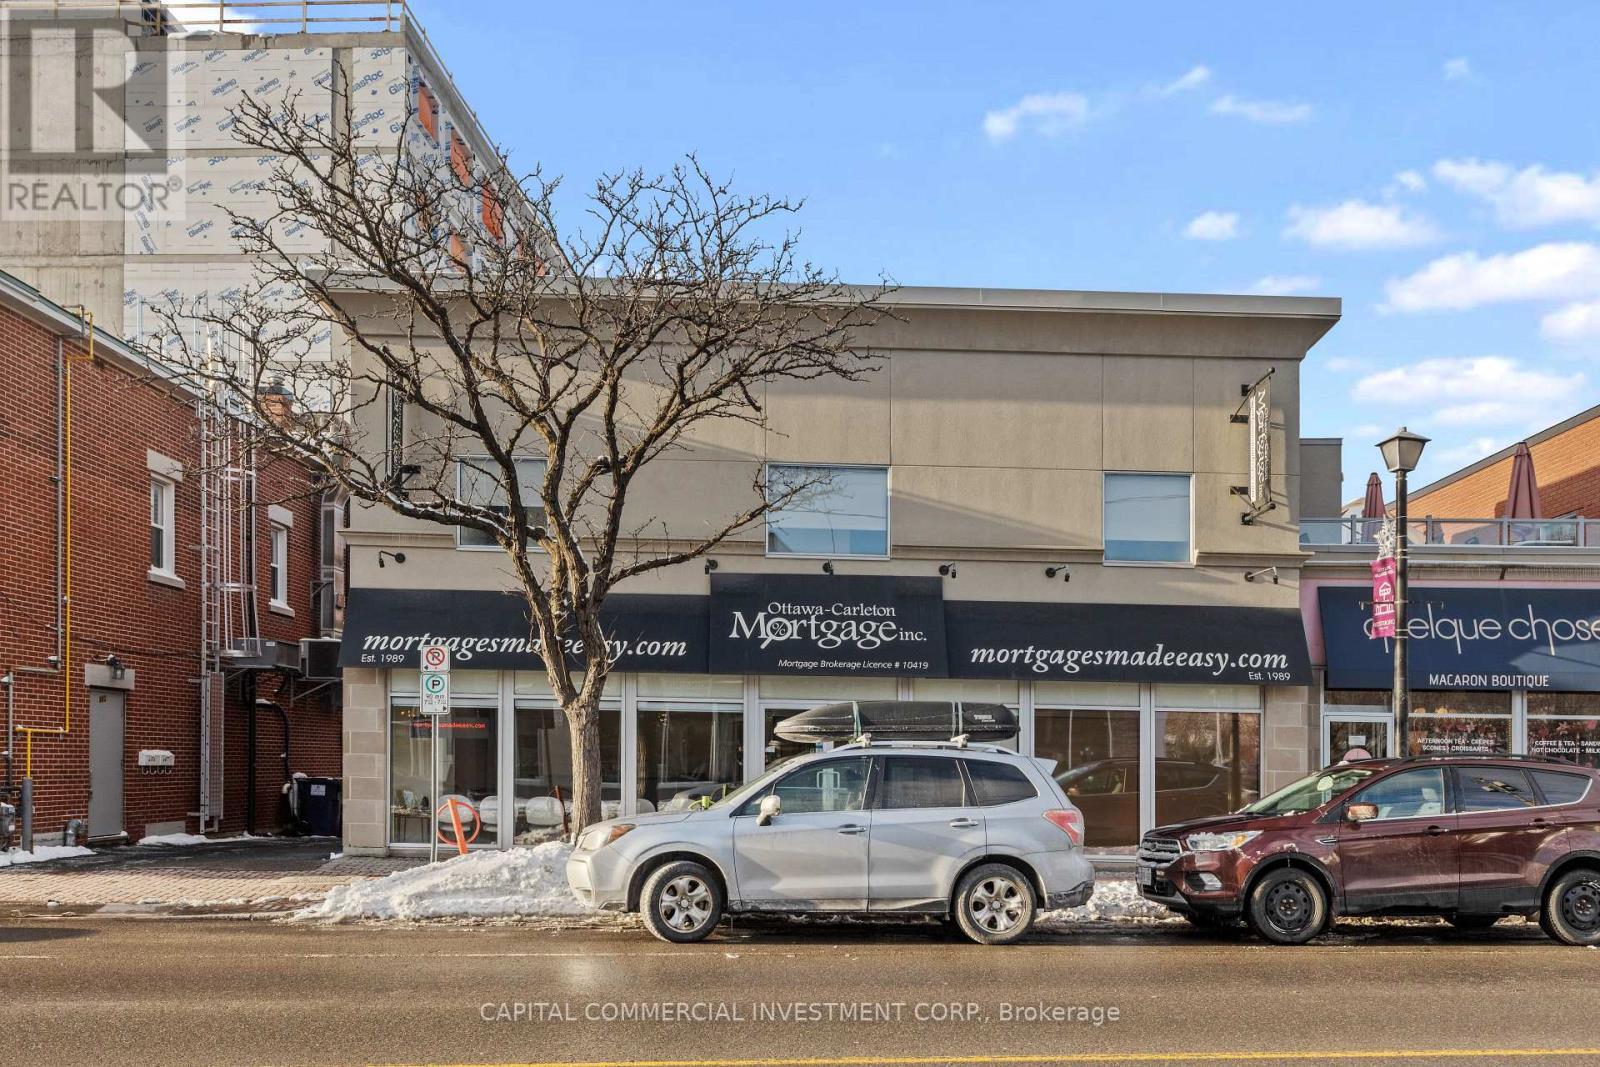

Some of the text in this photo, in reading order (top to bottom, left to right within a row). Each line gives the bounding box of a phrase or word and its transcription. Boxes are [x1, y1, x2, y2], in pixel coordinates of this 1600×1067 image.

[729, 611, 927, 649] Mortgage inc.
[1363, 603, 1502, 654] qelque
[362, 632, 687, 663] mortagesmaeey.com
[361, 654, 405, 663] Est. 1989
[778, 659, 818, 669] Mortgage
[820, 660, 862, 669] Brokerage
[863, 660, 892, 668] Licence
[902, 661, 929, 670] 10419
[970, 644, 1288, 676] mortgagesmadeeasy.com
[1248, 671, 1291, 681] Est. 1989
[1429, 674, 1550, 687] MACARON BOUTIQUE
[432, 679, 441, 689] P
